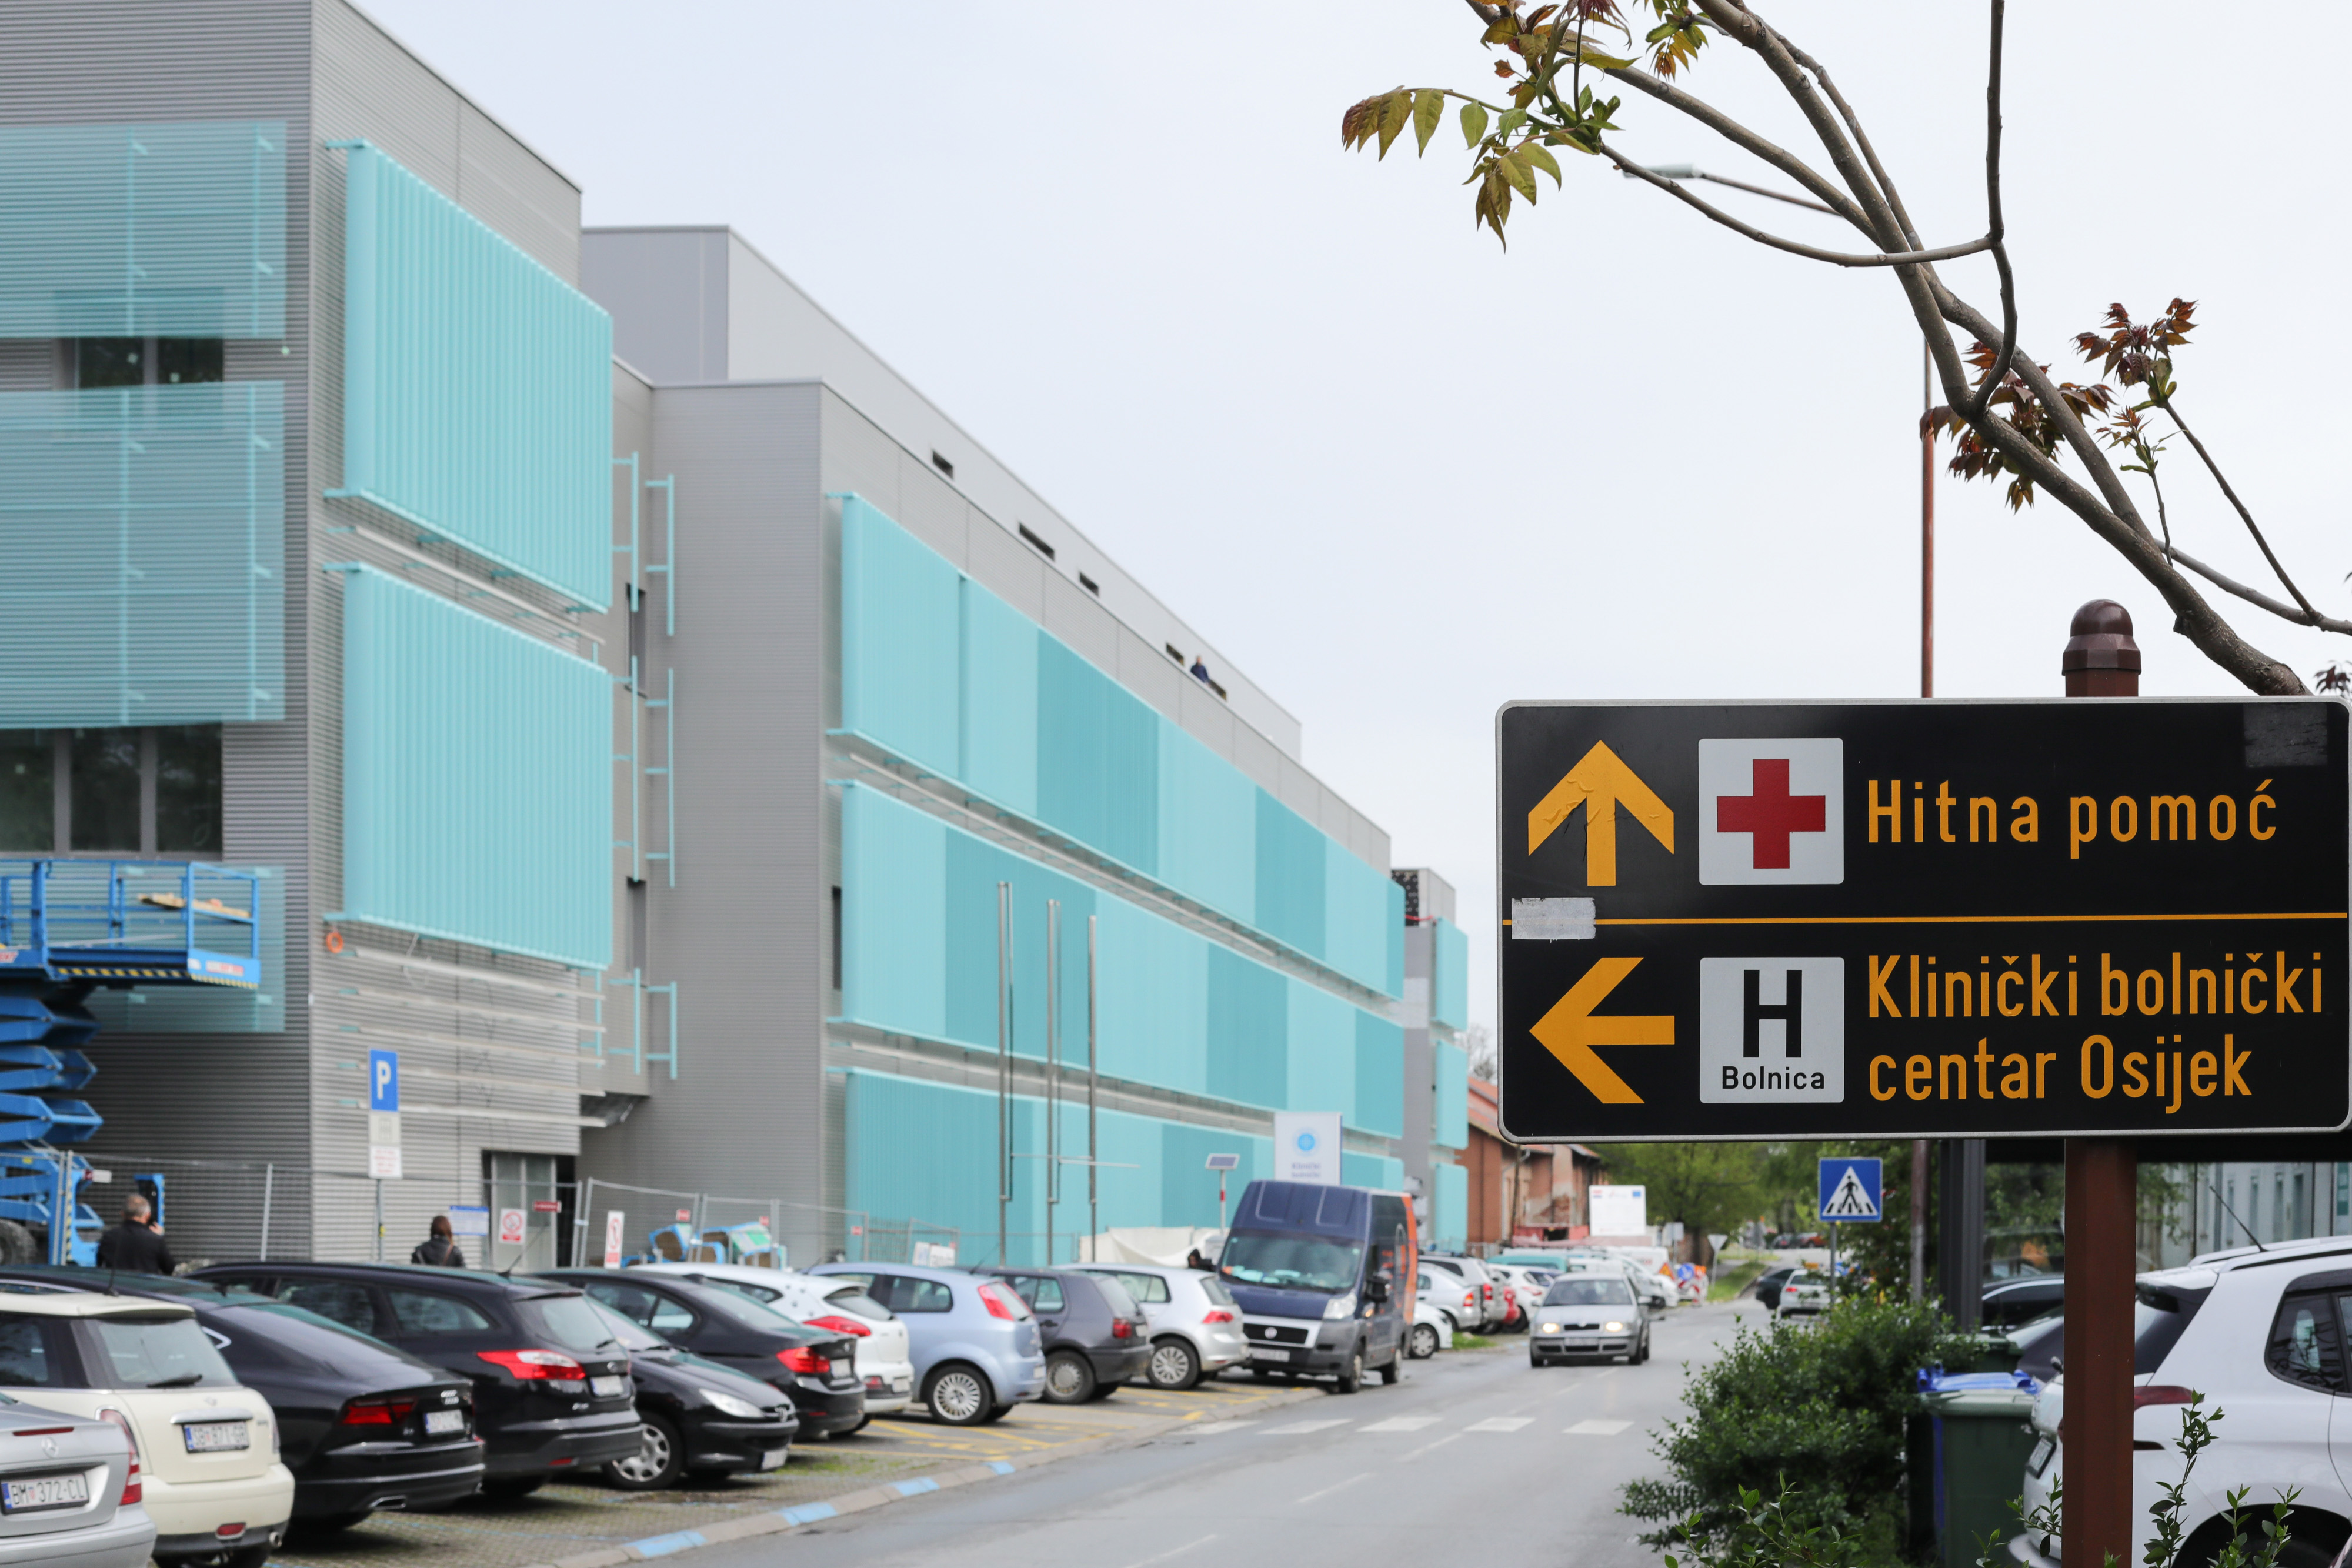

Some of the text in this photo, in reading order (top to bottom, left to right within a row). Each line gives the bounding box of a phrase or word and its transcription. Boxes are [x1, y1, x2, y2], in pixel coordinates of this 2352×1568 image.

[1868, 779, 2276, 859] Hitna pomoć
[1743, 969, 1803, 1058] H
[1869, 950, 2322, 1018] Klinički bolnički
[376, 1060, 391, 1100] P
[1722, 1066, 1824, 1090] Bolnica
[1869, 1033, 2252, 1114] centar Osijek
[36, 1479, 85, 1502] 372-CL
